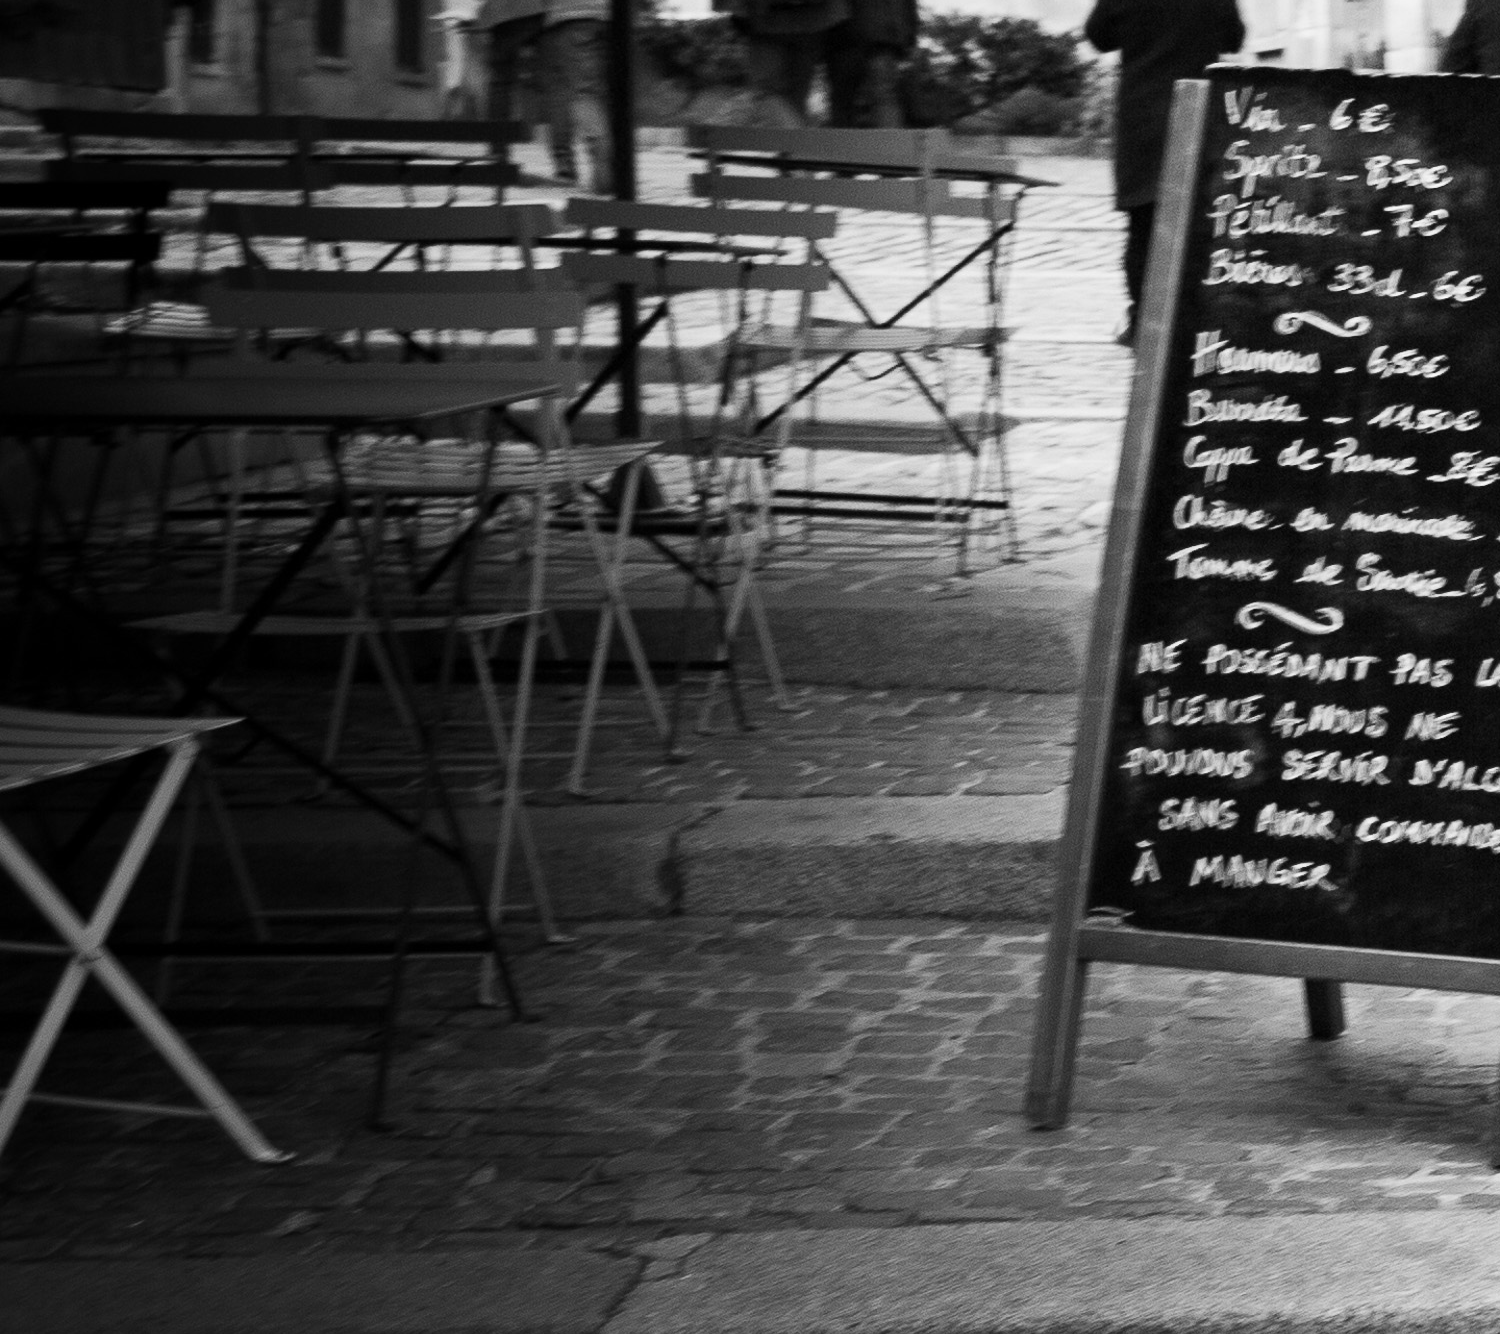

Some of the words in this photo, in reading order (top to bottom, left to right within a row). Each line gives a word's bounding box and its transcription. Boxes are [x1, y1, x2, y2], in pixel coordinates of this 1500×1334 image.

[1224, 86, 1288, 132] Vin
[1223, 139, 1328, 198] Spritz
[1277, 439, 1323, 471] de
[1293, 556, 1344, 586] de
[1136, 638, 1188, 674] NE
[1389, 652, 1455, 687] PAS
[1404, 711, 1462, 741] NE
[1120, 746, 1256, 779] POUVONS
[1157, 797, 1240, 832] SANS
[1130, 839, 1162, 885] À
[1189, 854, 1339, 891] MANGER
